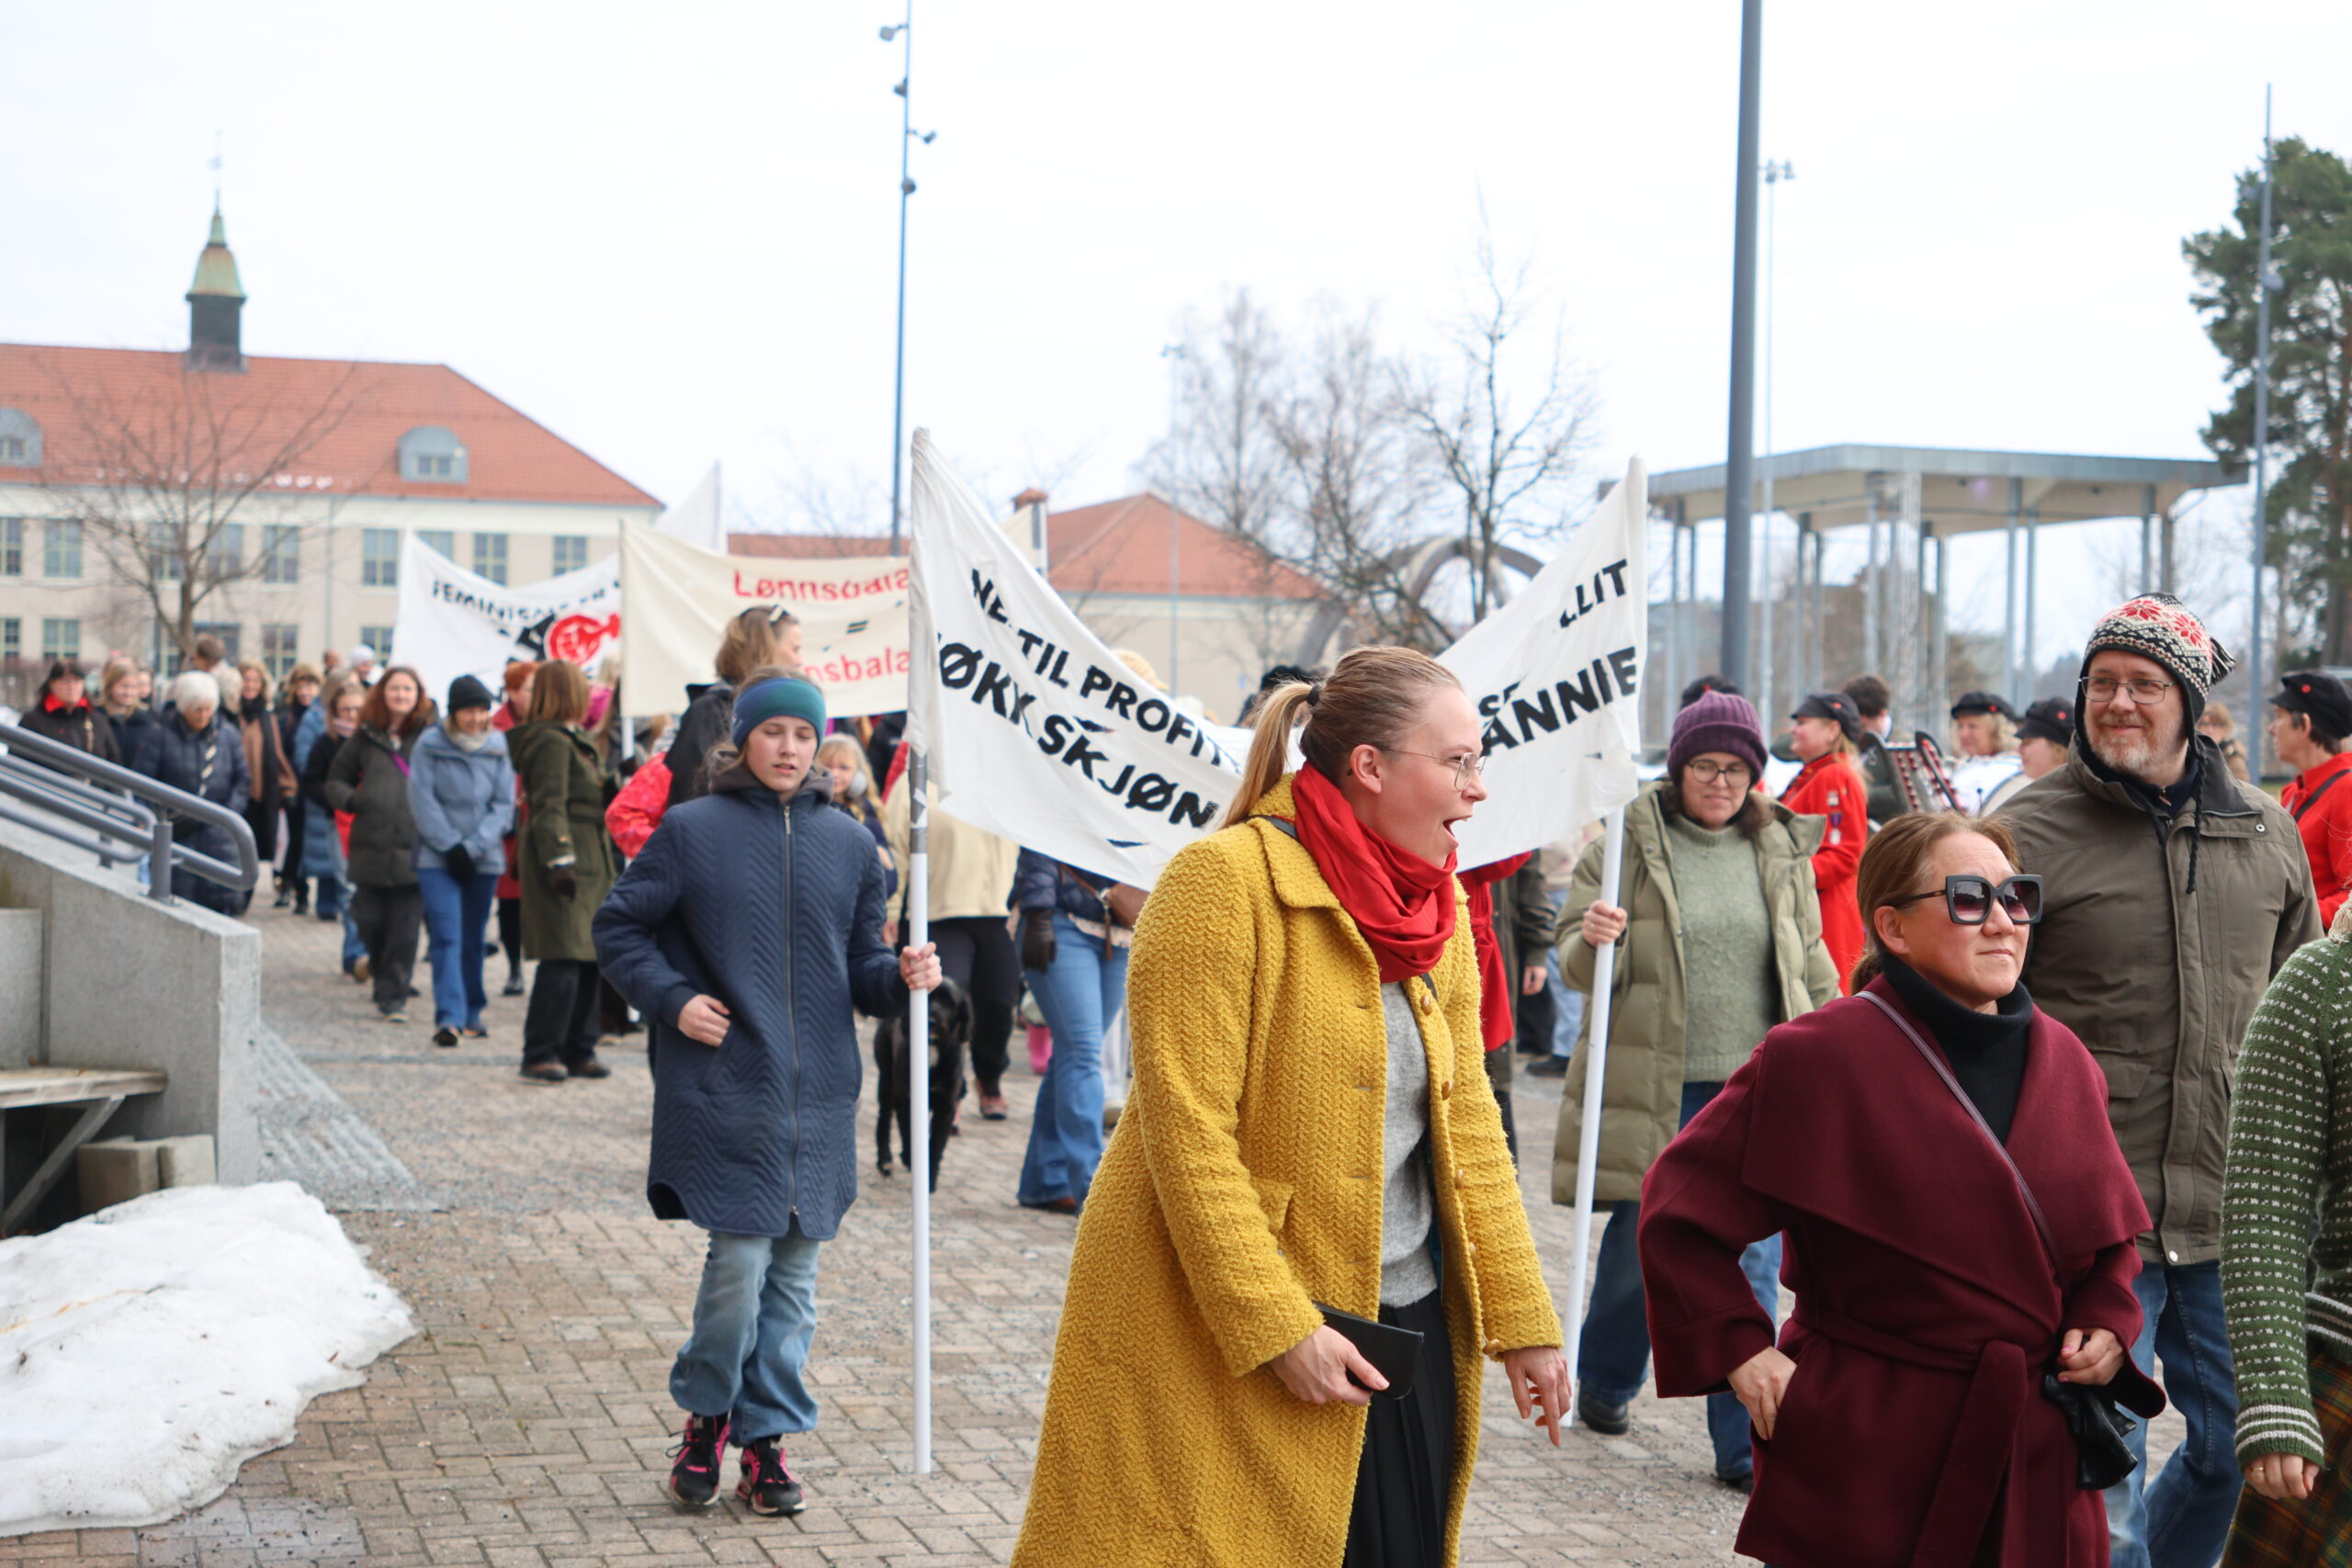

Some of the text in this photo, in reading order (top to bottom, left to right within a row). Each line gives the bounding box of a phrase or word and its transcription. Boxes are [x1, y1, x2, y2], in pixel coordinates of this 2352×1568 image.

[1017, 627, 1069, 689] TIL
[1036, 714, 1220, 829] SKJØN
[1479, 646, 1636, 757] ANNIE
